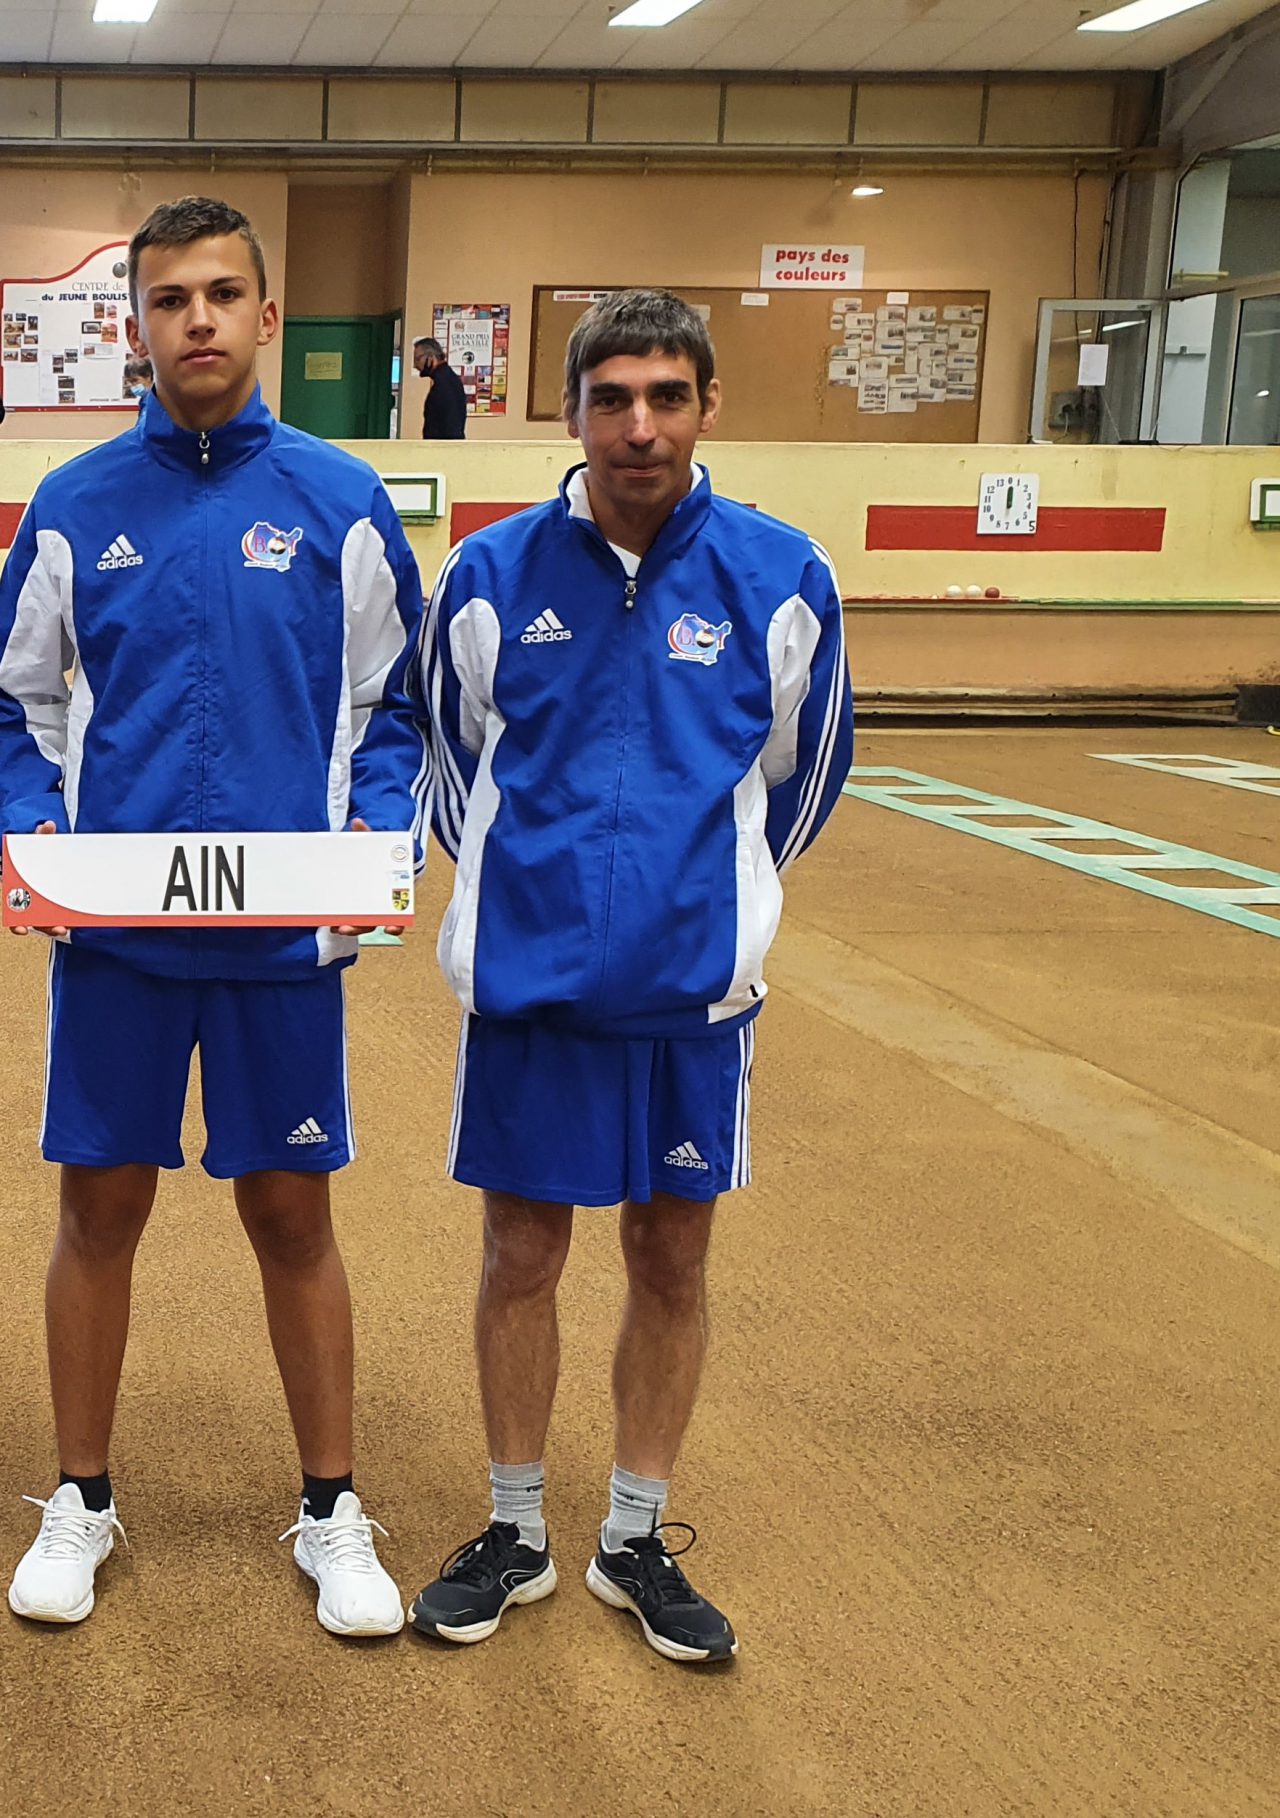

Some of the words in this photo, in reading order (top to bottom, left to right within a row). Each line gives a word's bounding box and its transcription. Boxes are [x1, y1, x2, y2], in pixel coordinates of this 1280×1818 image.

[775, 249, 816, 264] pays
[821, 248, 849, 263] des
[775, 266, 847, 281] couleurs
[71, 281, 109, 291] CENTRE
[41, 293, 54, 301] du
[58, 293, 88, 301] JEUNE
[92, 293, 129, 301] BOULIS
[996, 478, 1004, 487] 13
[987, 485, 995, 494] 12
[984, 495, 991, 503] 11
[983, 505, 991, 513] 10
[1028, 520, 1036, 532] 5
[96, 554, 144, 570] adidas
[520, 629, 573, 644] adidas
[161, 844, 245, 912] AIN
[286, 1133, 329, 1144] adidas
[663, 1156, 709, 1170] adidas
